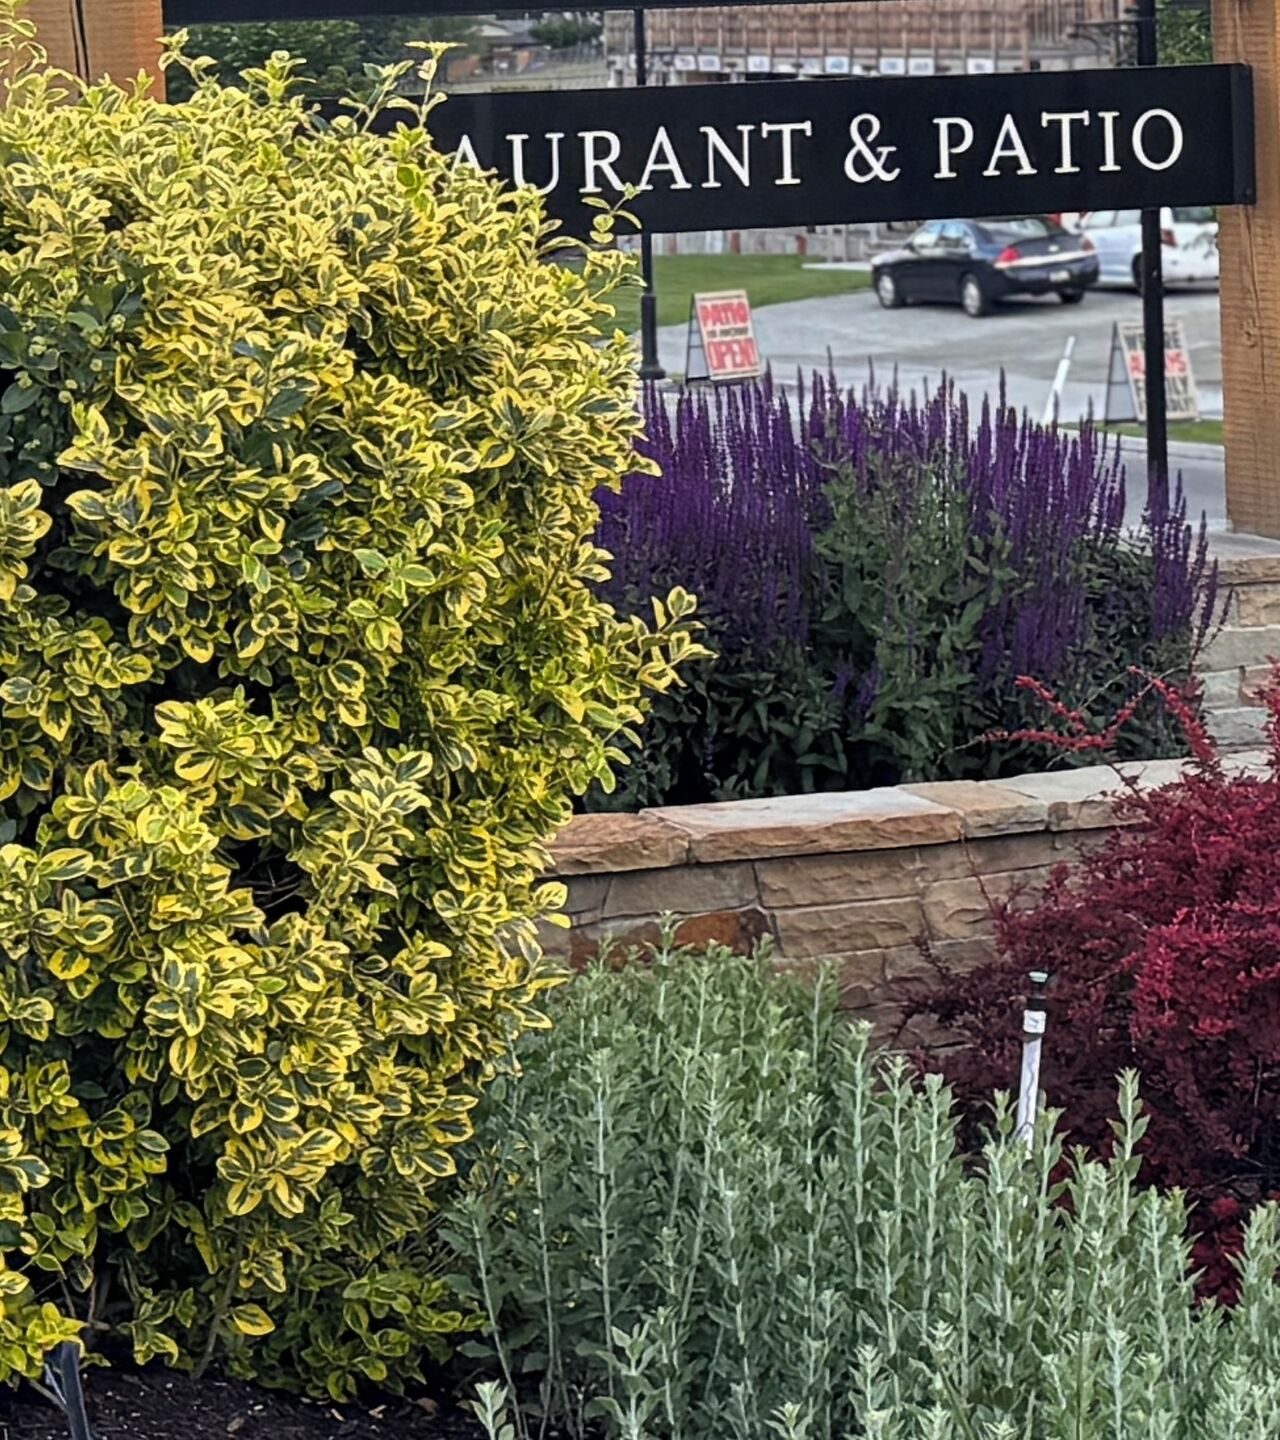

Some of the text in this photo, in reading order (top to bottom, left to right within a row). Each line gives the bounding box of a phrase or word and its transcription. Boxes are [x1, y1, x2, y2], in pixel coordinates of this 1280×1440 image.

[447, 108, 1184, 197] AURANT & PATIO
[707, 338, 758, 370] OPEN
